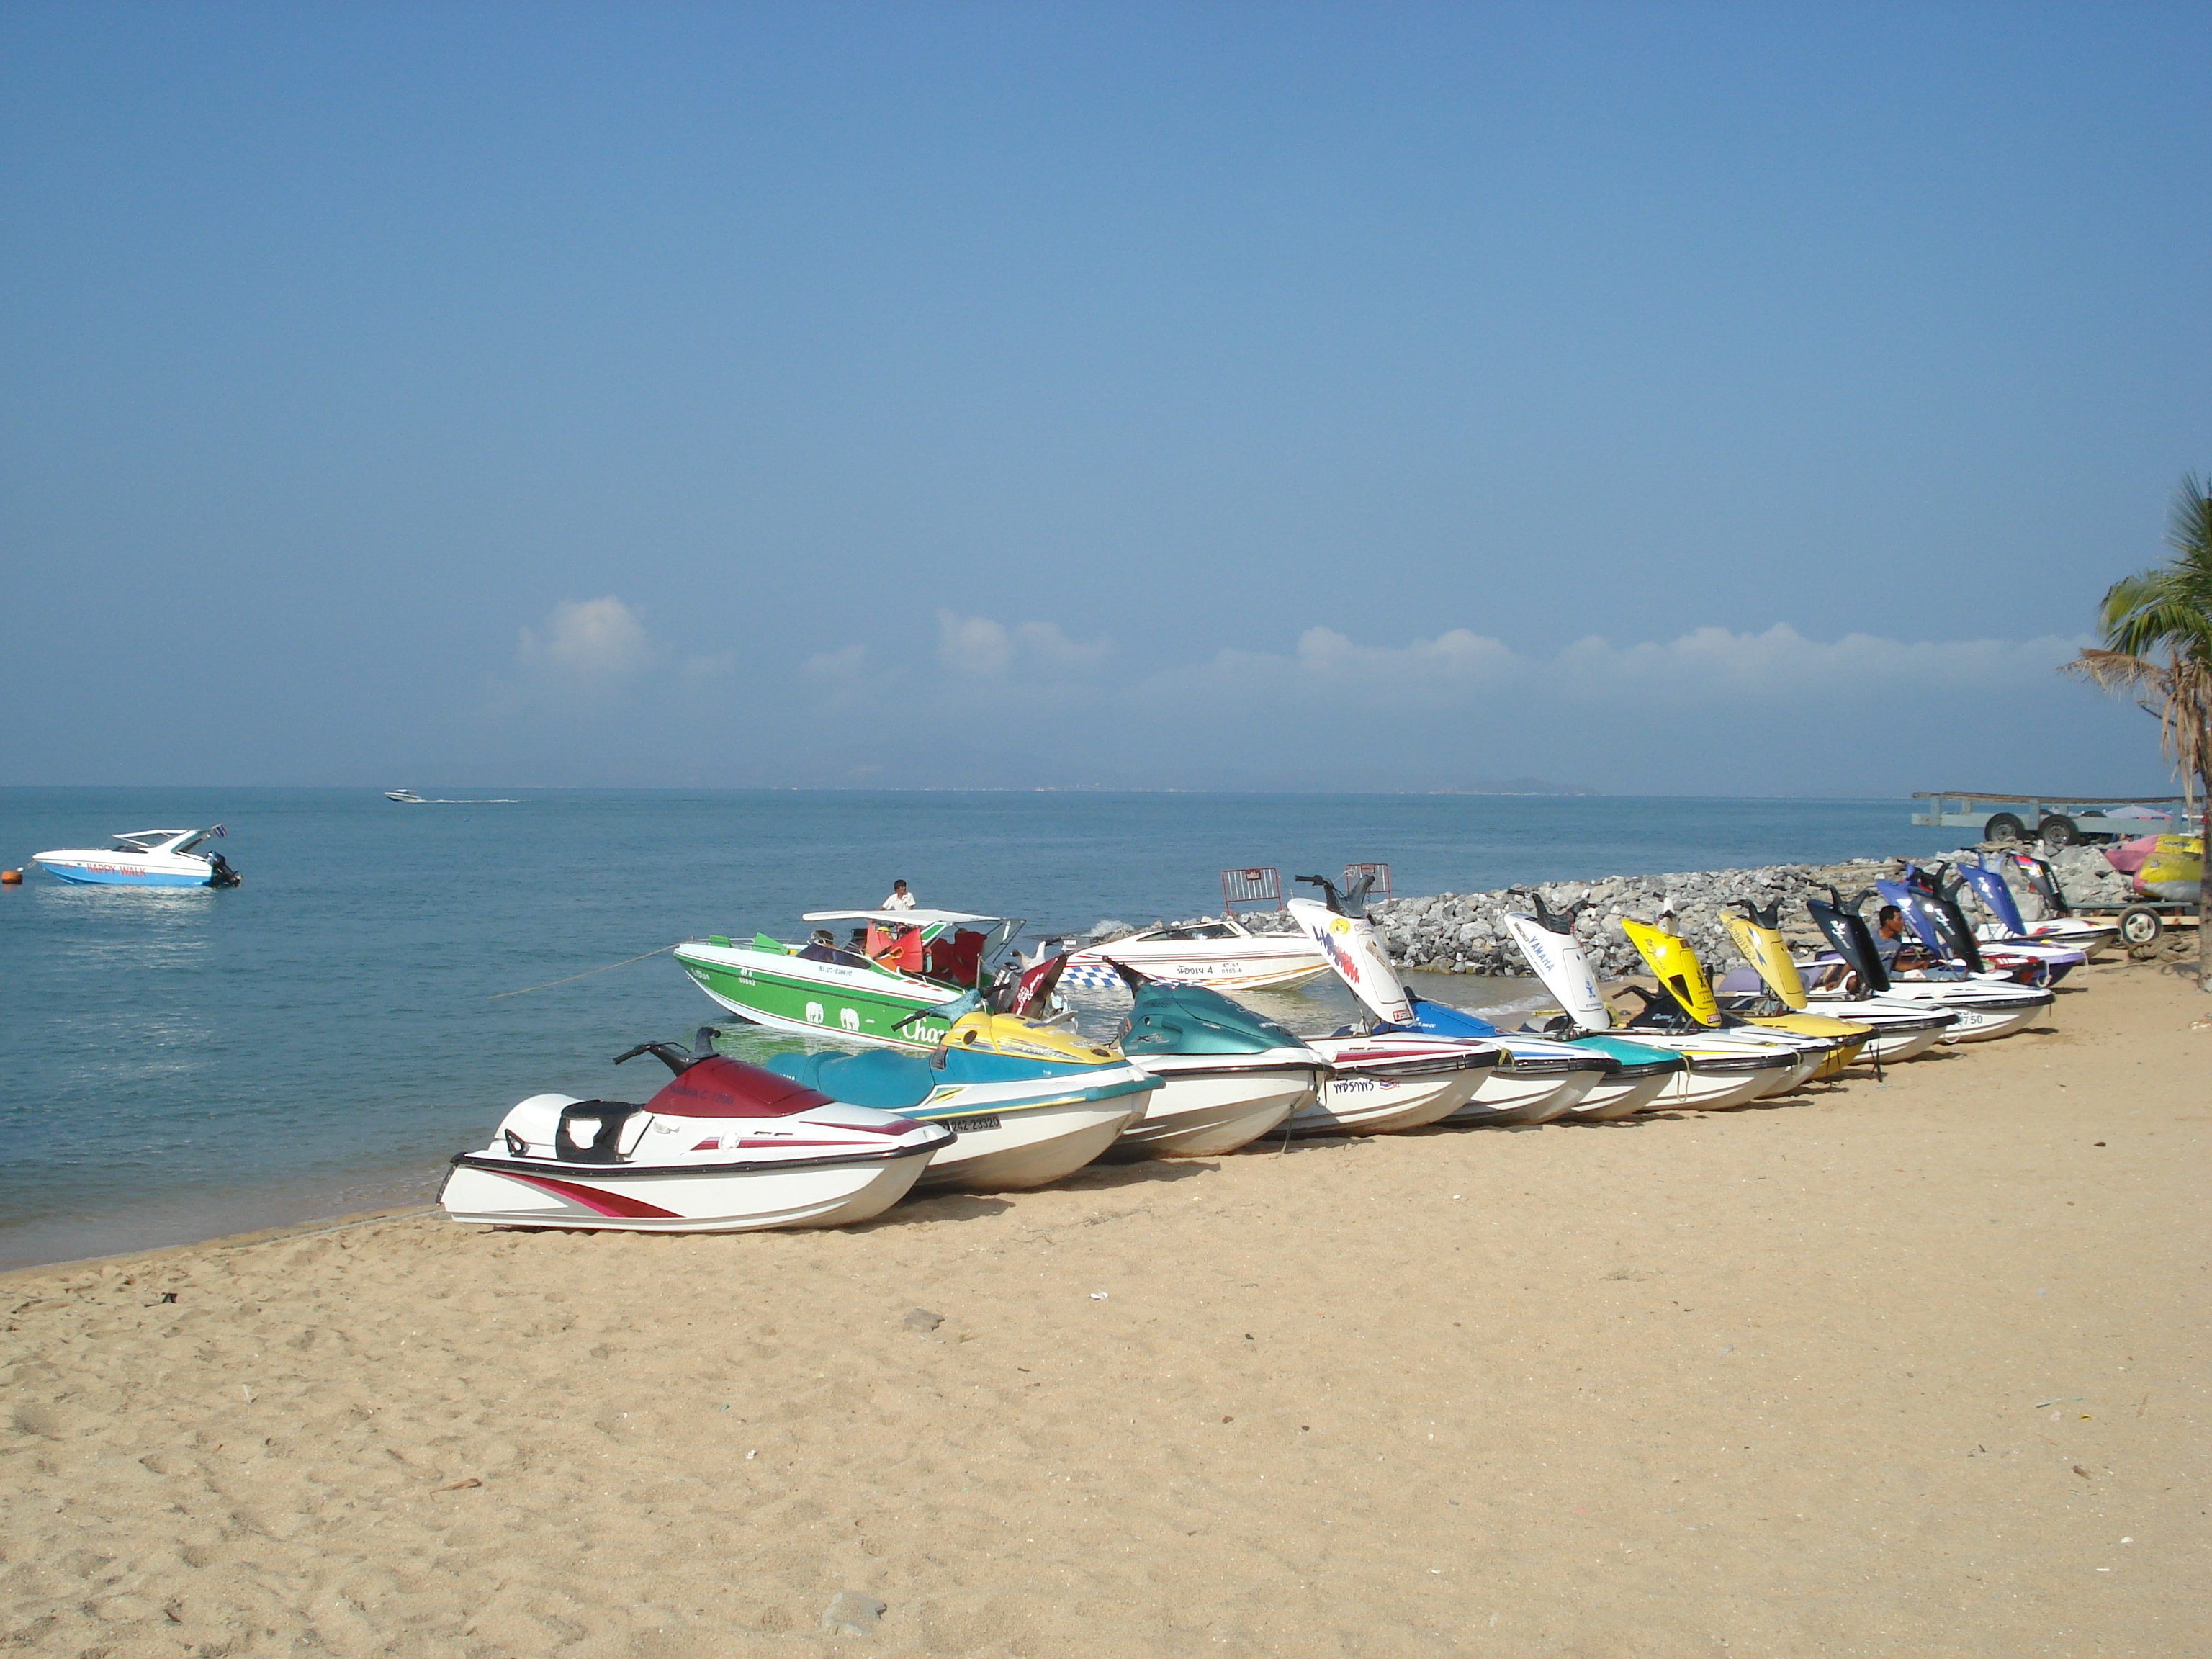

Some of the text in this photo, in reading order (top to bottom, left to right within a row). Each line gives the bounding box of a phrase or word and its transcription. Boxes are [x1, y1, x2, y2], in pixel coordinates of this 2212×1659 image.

[86, 863, 116, 875] HAPPY
[120, 866, 147, 877] WALK
[1527, 935, 1556, 972] YAMAHA
